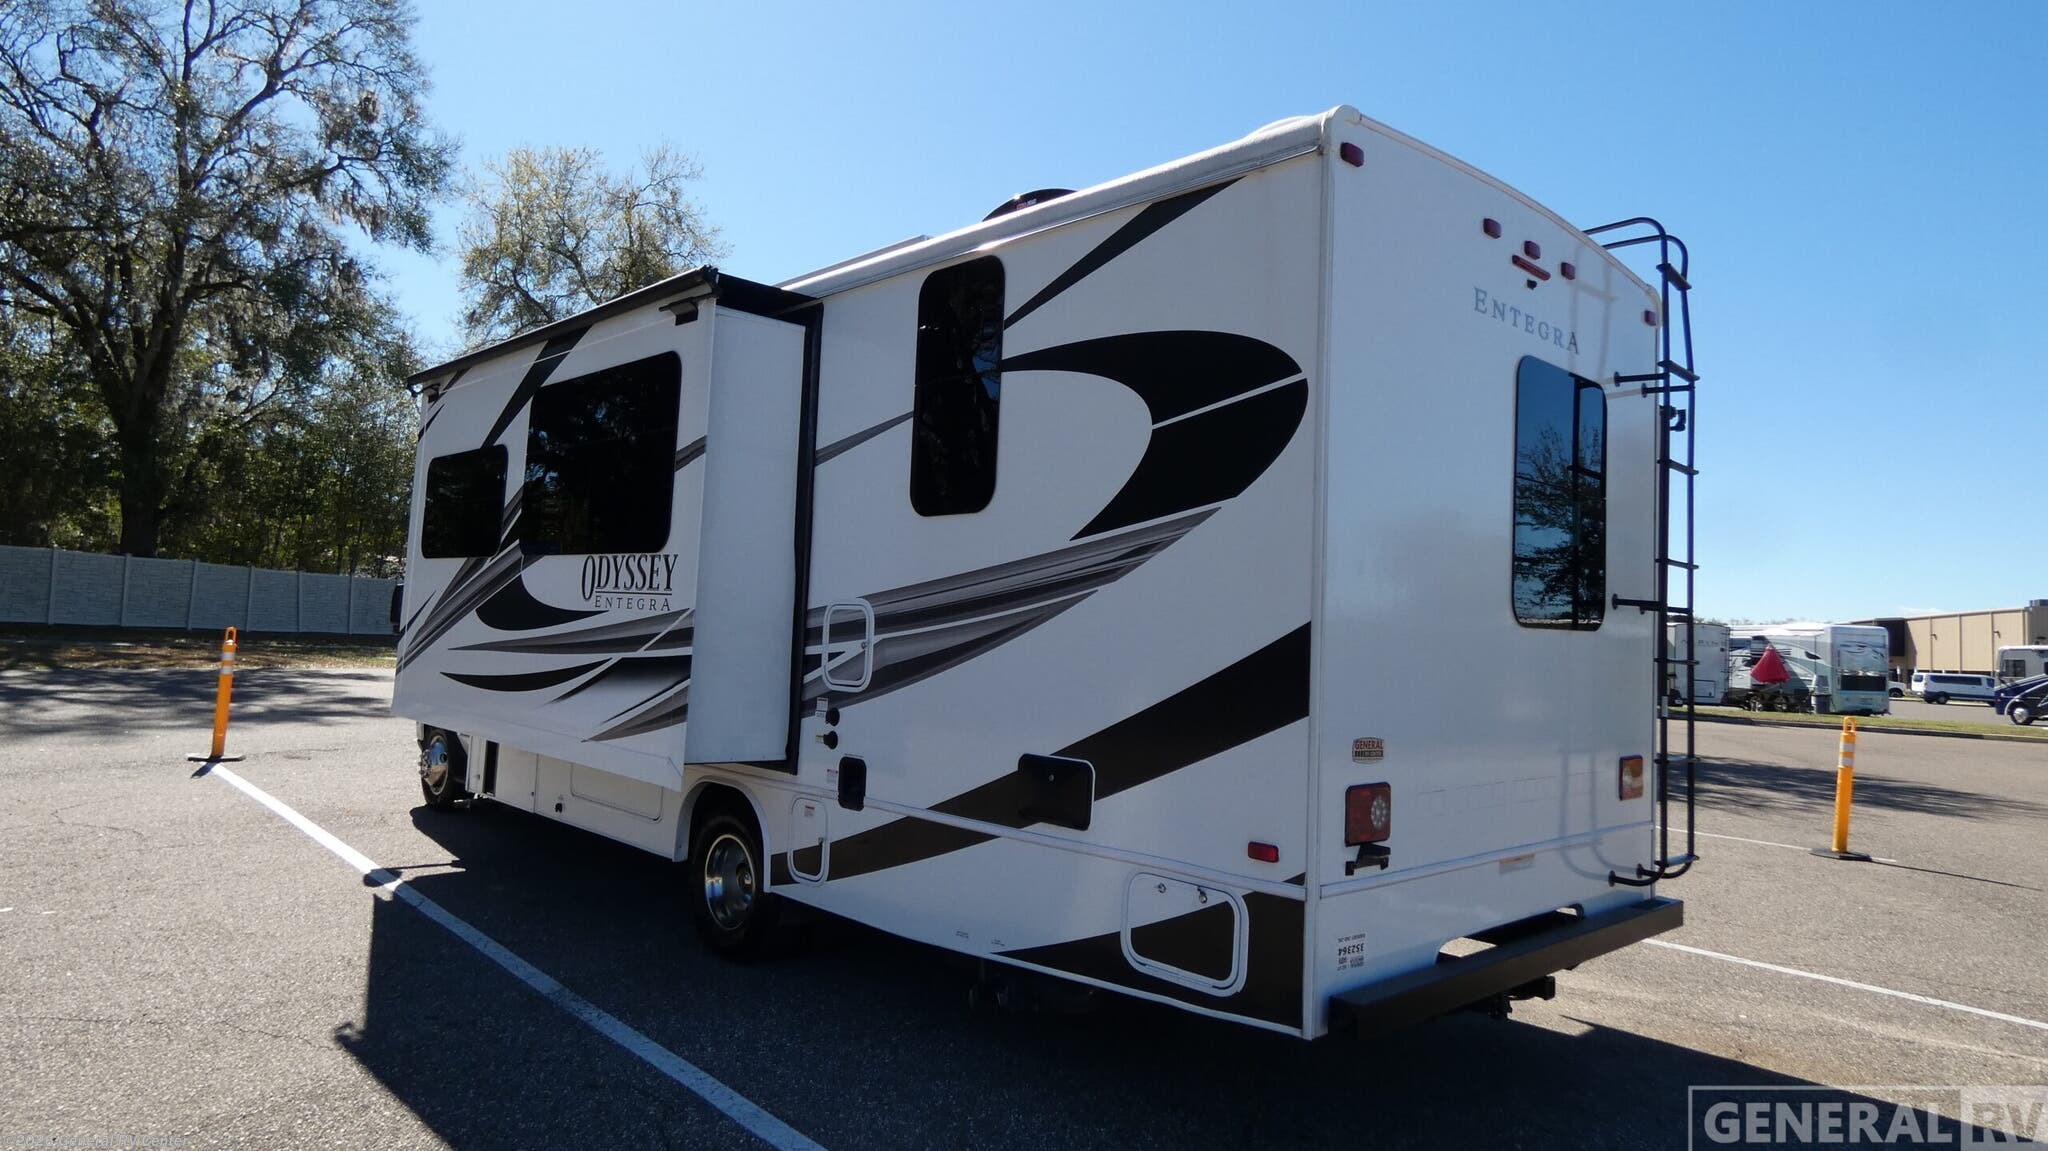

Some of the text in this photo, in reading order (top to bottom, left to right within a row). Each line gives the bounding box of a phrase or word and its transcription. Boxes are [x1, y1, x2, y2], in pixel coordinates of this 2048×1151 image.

[1473, 286, 1580, 355] ENTEGRA
[581, 553, 679, 601] ODYSSEY
[594, 595, 671, 611] ENTEGRA
[1338, 942, 1365, 957] 352364
